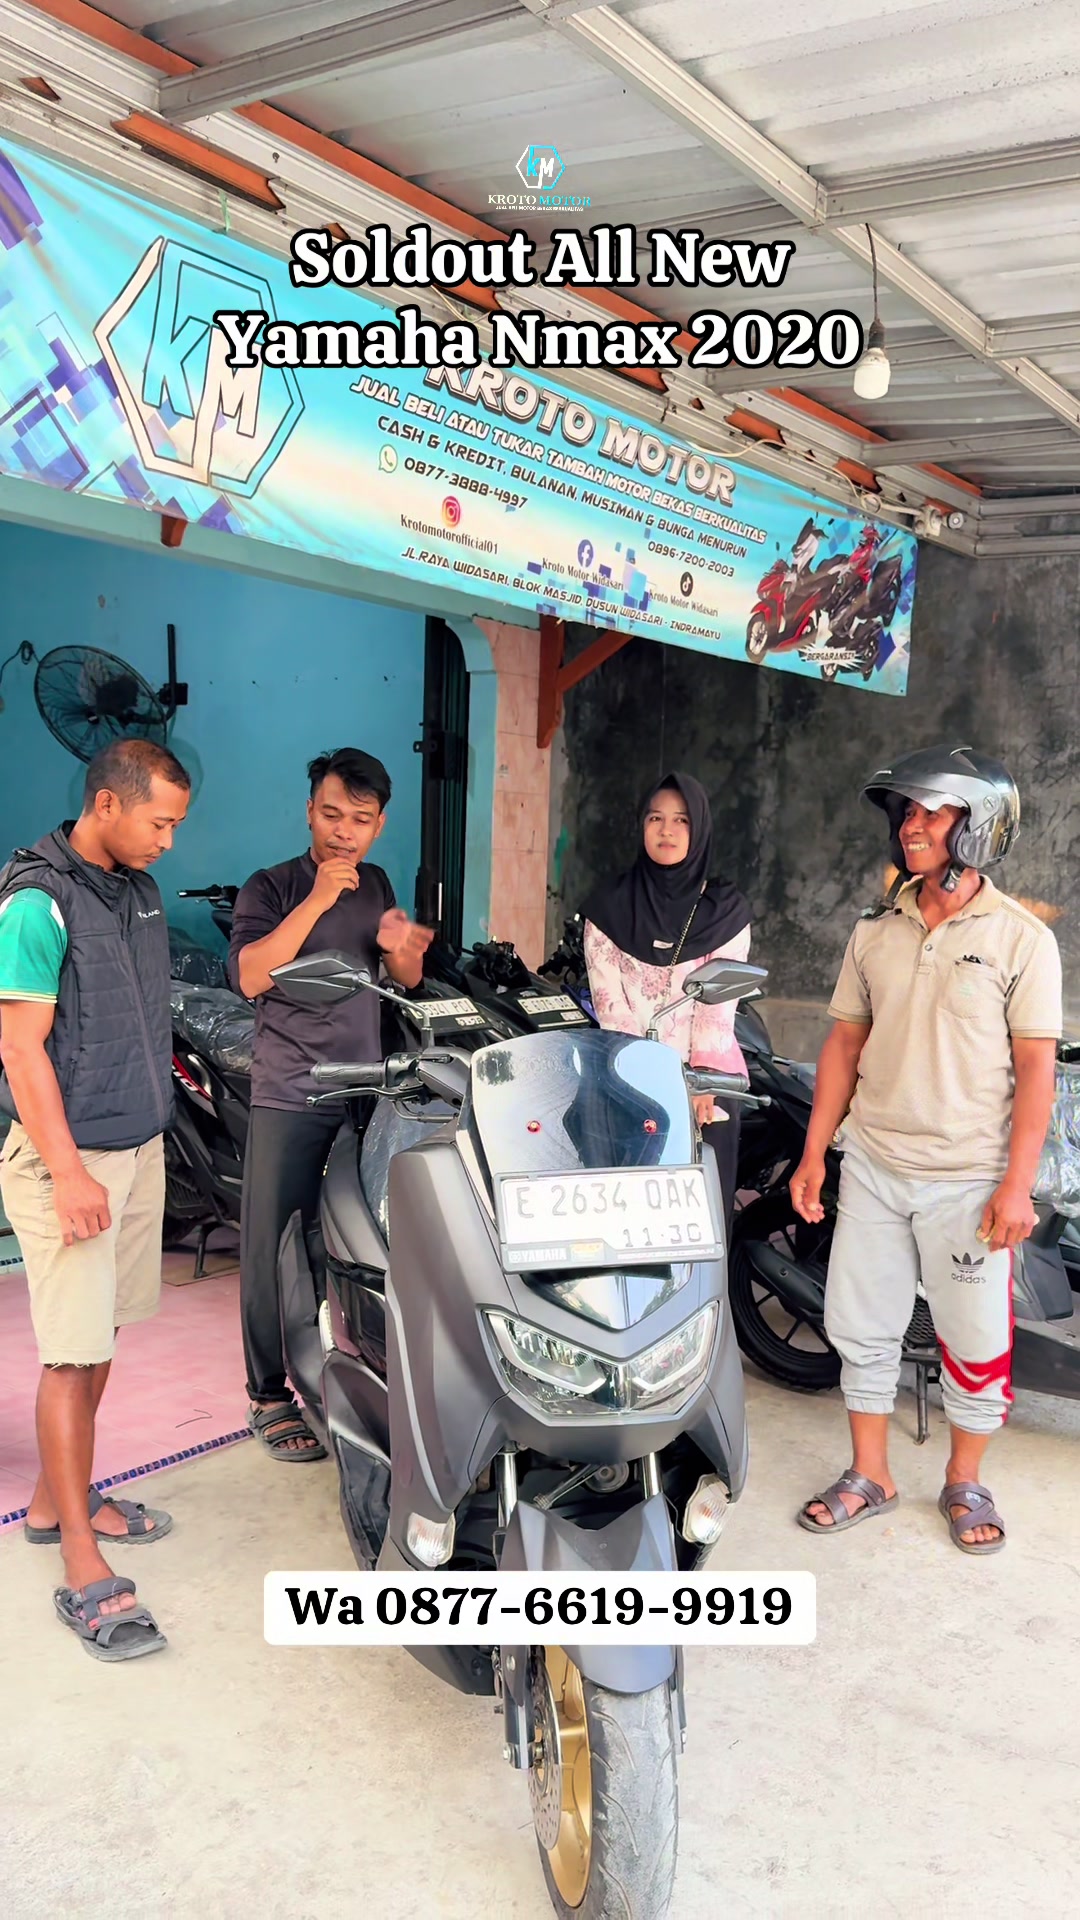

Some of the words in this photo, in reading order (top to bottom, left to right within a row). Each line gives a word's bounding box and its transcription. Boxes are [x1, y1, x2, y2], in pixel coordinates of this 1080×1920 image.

[350, 375, 401, 407] JUAL
[403, 393, 446, 424] BELI
[444, 410, 491, 440] ATAU
[492, 427, 545, 462] TUKAR
[547, 448, 605, 484] TAMBAH
[605, 471, 652, 502] MOTOR
[651, 490, 695, 517] BEKAS
[693, 505, 767, 544] BERKUALITAS
[598, 416, 736, 507] MOTOR
[377, 416, 425, 444] CASH
[427, 435, 440, 449] &
[581, 491, 645, 523] MUSIMAN
[645, 514, 655, 526] &
[657, 519, 695, 539] BUNGA
[697, 532, 747, 558] MENURUN
[404, 457, 528, 508] 0877-3888-4997
[400, 514, 499, 555] Krotomotorofficial01
[542, 558, 565, 574] Kroto
[567, 564, 590, 581] Motor
[591, 570, 624, 591] Widasari
[512, 578, 541, 594] BLOK
[586, 598, 618, 615] DUSUN
[620, 607, 664, 626] WIDASARI
[670, 620, 721, 640] INDRAMAYU
[649, 587, 668, 604] Kroto
[670, 594, 689, 610] Motor
[691, 600, 719, 617] Widasari
[516, 1187, 535, 1218] E
[551, 1182, 628, 1216] 2634
[521, 1248, 567, 1262] YAMAHA
[951, 1272, 986, 1284] adidas
